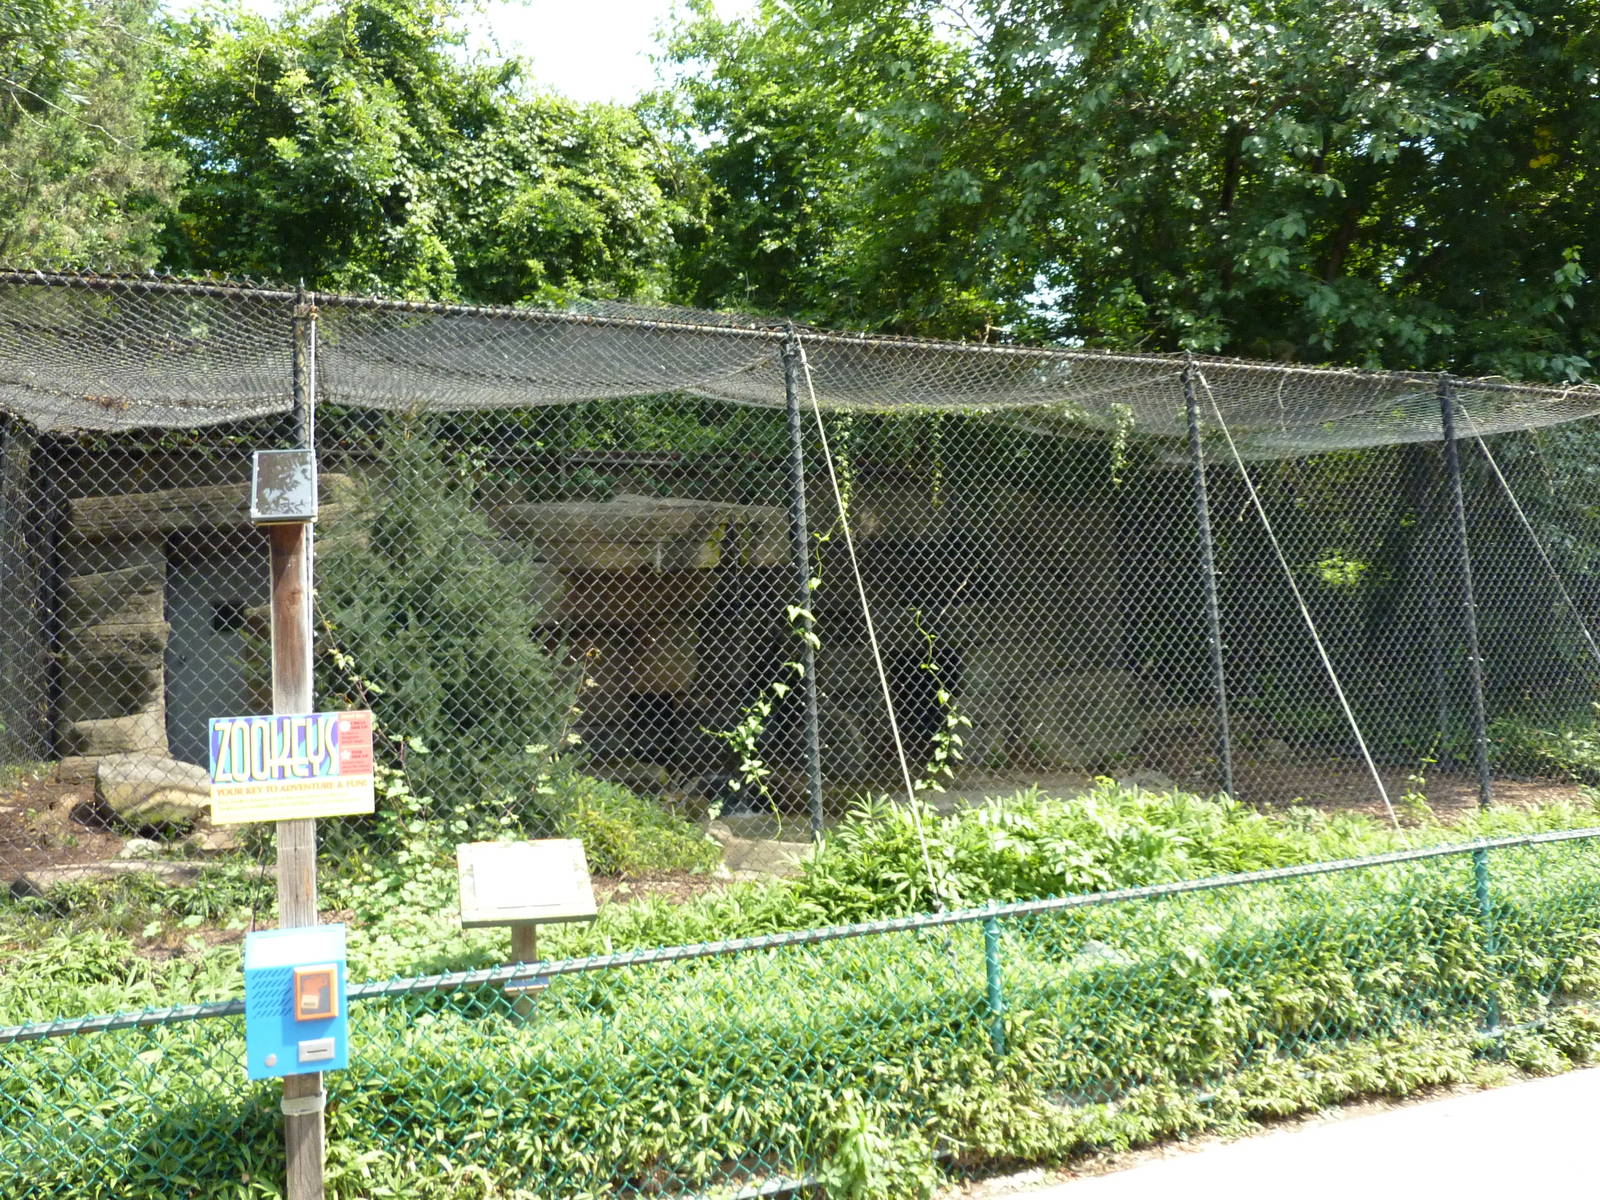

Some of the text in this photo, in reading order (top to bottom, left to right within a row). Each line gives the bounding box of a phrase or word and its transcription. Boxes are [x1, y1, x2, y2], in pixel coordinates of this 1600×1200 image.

[214, 716, 338, 783] ZOOKEYS
[217, 788, 244, 797] YOUR
[246, 786, 262, 795] KEY
[266, 785, 278, 793] TO
[280, 782, 333, 792] ADVENTURE
